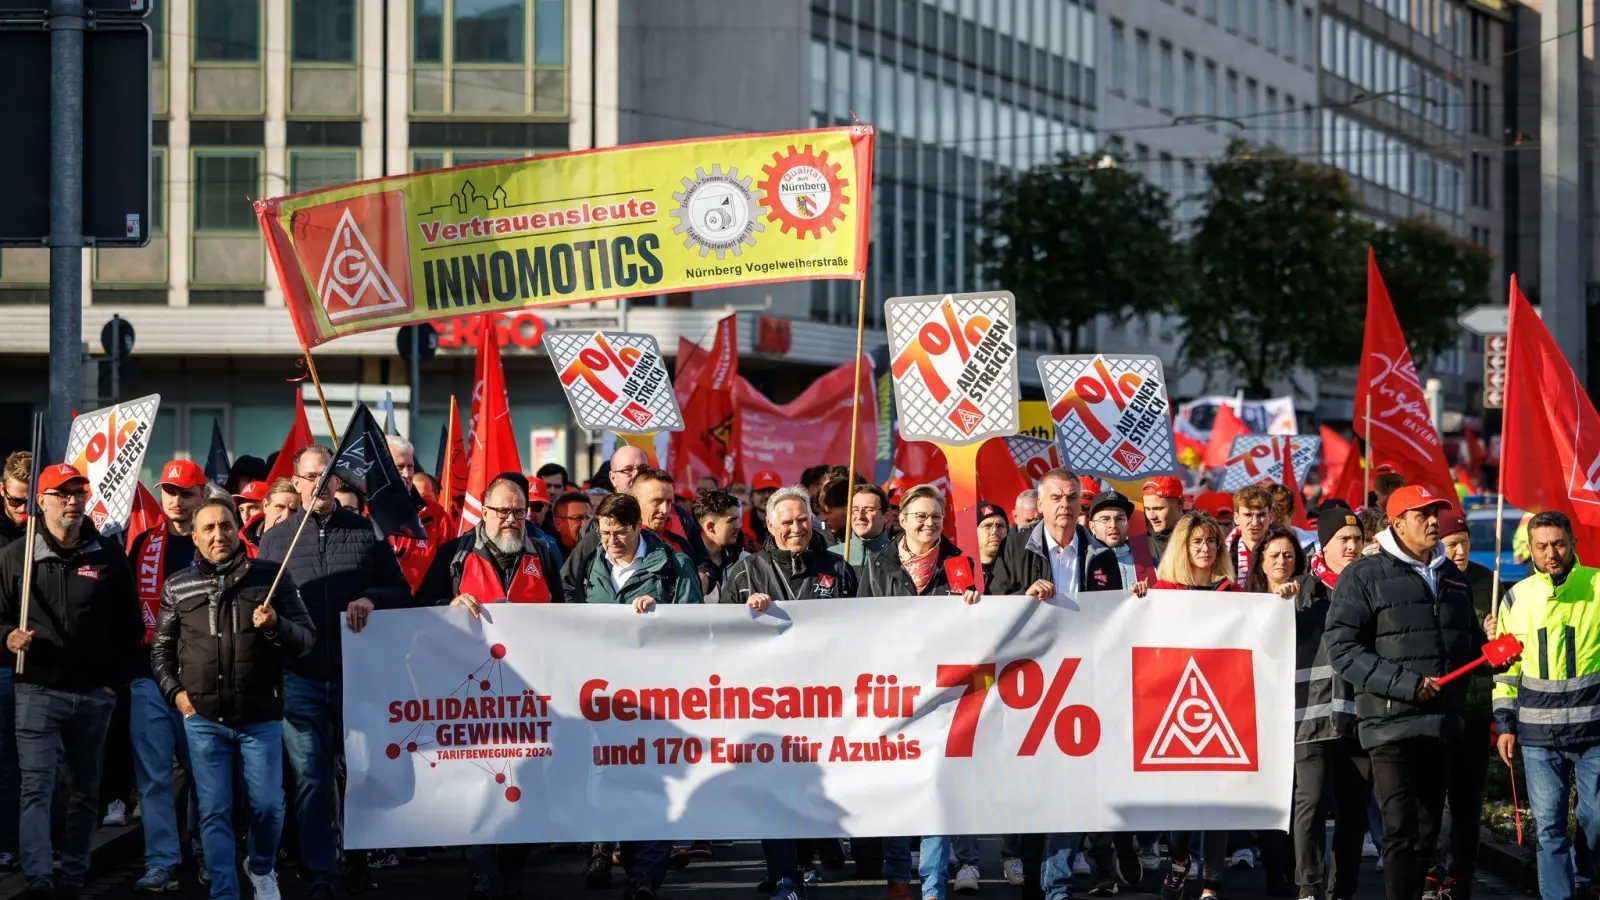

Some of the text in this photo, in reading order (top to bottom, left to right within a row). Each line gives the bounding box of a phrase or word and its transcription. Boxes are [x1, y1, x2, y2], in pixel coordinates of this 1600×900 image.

[702, 176, 723, 185] Siemens
[730, 178, 752, 201] Innomotics
[781, 181, 827, 192] Nürnberg
[420, 199, 658, 243] Vertrauensleute
[686, 226, 737, 250] Traditionsstandort
[423, 232, 664, 311] INNOMOTICS
[686, 256, 848, 279] Nürnberg Vogelweiherstraße
[560, 333, 641, 405] 7%
[622, 351, 658, 398] AUF EINEN
[891, 298, 992, 405] 7%
[956, 319, 1009, 393] AUF EINEN
[969, 341, 1014, 402] STREICH
[634, 366, 666, 406] STREICH
[1051, 360, 1143, 445] 7%
[1117, 377, 1160, 437] AUF EINEN
[1128, 397, 1166, 446] STREICH
[1402, 418, 1438, 446] BAYERN
[98, 421, 148, 495] AUF EINEN
[103, 442, 145, 502] STREICH
[141, 535, 164, 593] JETZT!
[388, 689, 552, 723] SOLIDARITÄT
[579, 673, 921, 722] Gemeinsam für
[936, 658, 1101, 757] 7%
[436, 721, 552, 746] GEWINNT
[436, 748, 552, 760] TARIFBEWEGUNG 2024
[593, 733, 922, 766] und 170 Euro für Azubis
